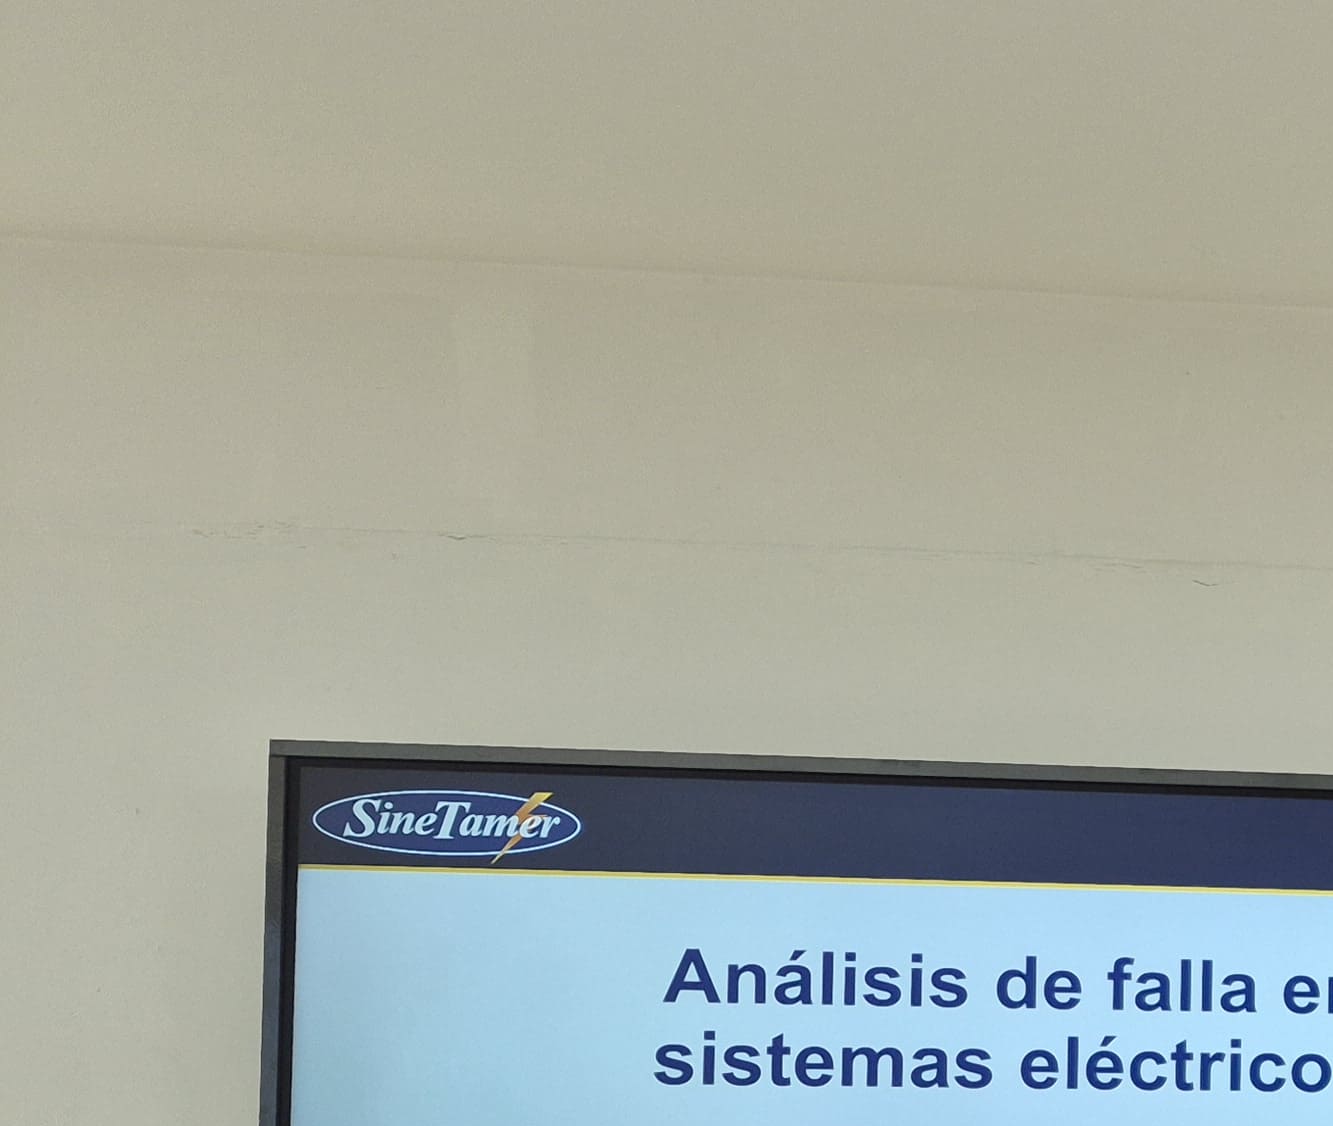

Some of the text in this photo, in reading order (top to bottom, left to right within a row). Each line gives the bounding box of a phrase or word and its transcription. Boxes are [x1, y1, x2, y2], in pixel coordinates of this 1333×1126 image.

[342, 798, 561, 840] SineTamer
[662, 947, 969, 1009] Análisis
[995, 956, 1083, 1010] de
[1107, 957, 1258, 1014] falla
[652, 1030, 994, 1089] sistemas
